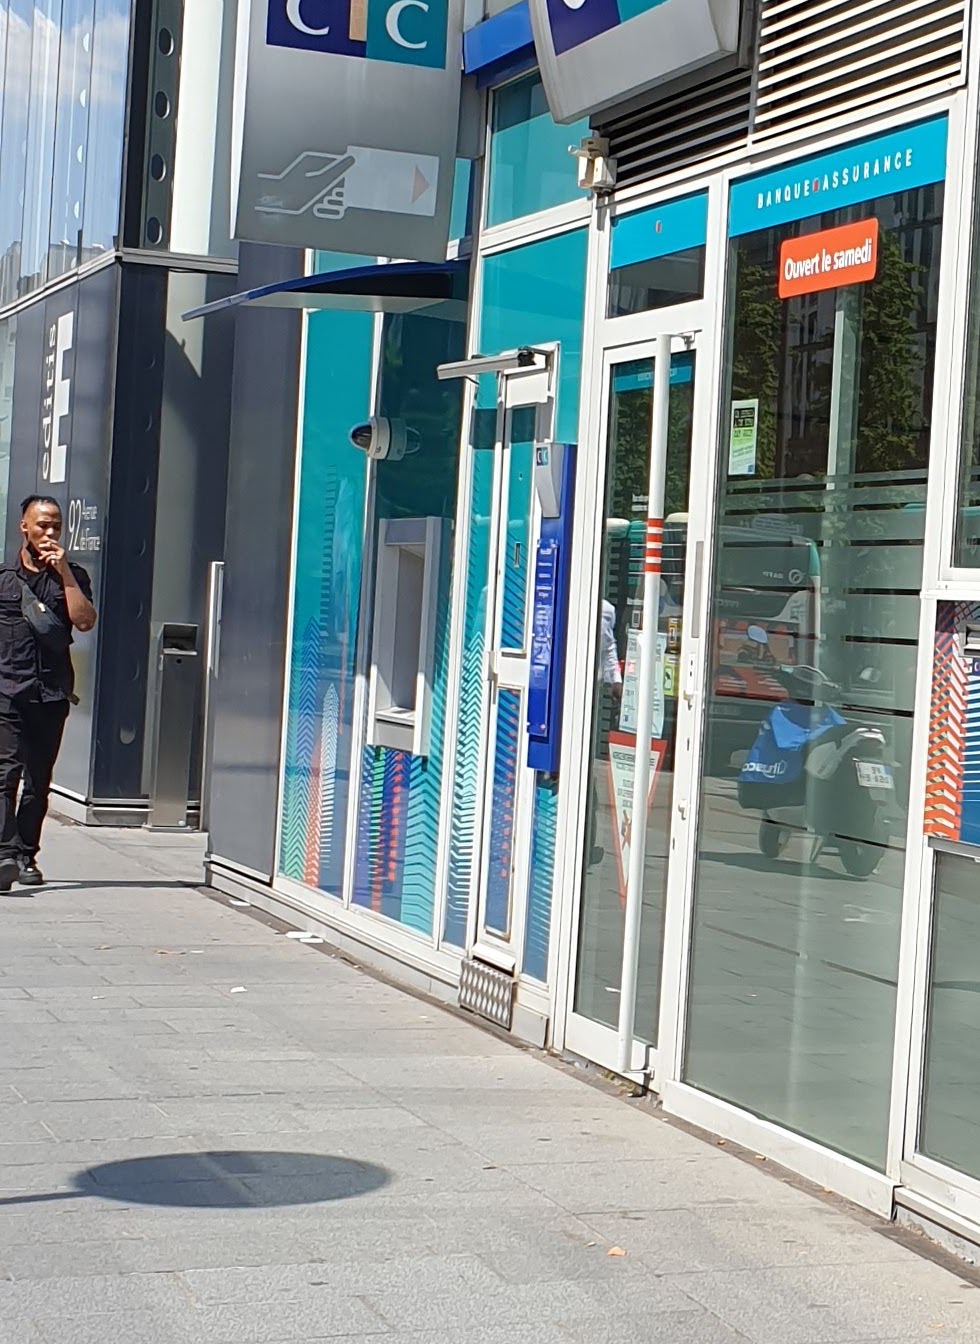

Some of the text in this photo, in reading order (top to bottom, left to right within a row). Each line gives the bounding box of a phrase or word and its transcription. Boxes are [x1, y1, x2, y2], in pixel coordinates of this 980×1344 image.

[757, 148, 913, 209] BANQUE ASSURANCE
[784, 238, 873, 281] Ouvert le samedi
[43, 324, 57, 481] editis
[68, 499, 82, 551] 92
